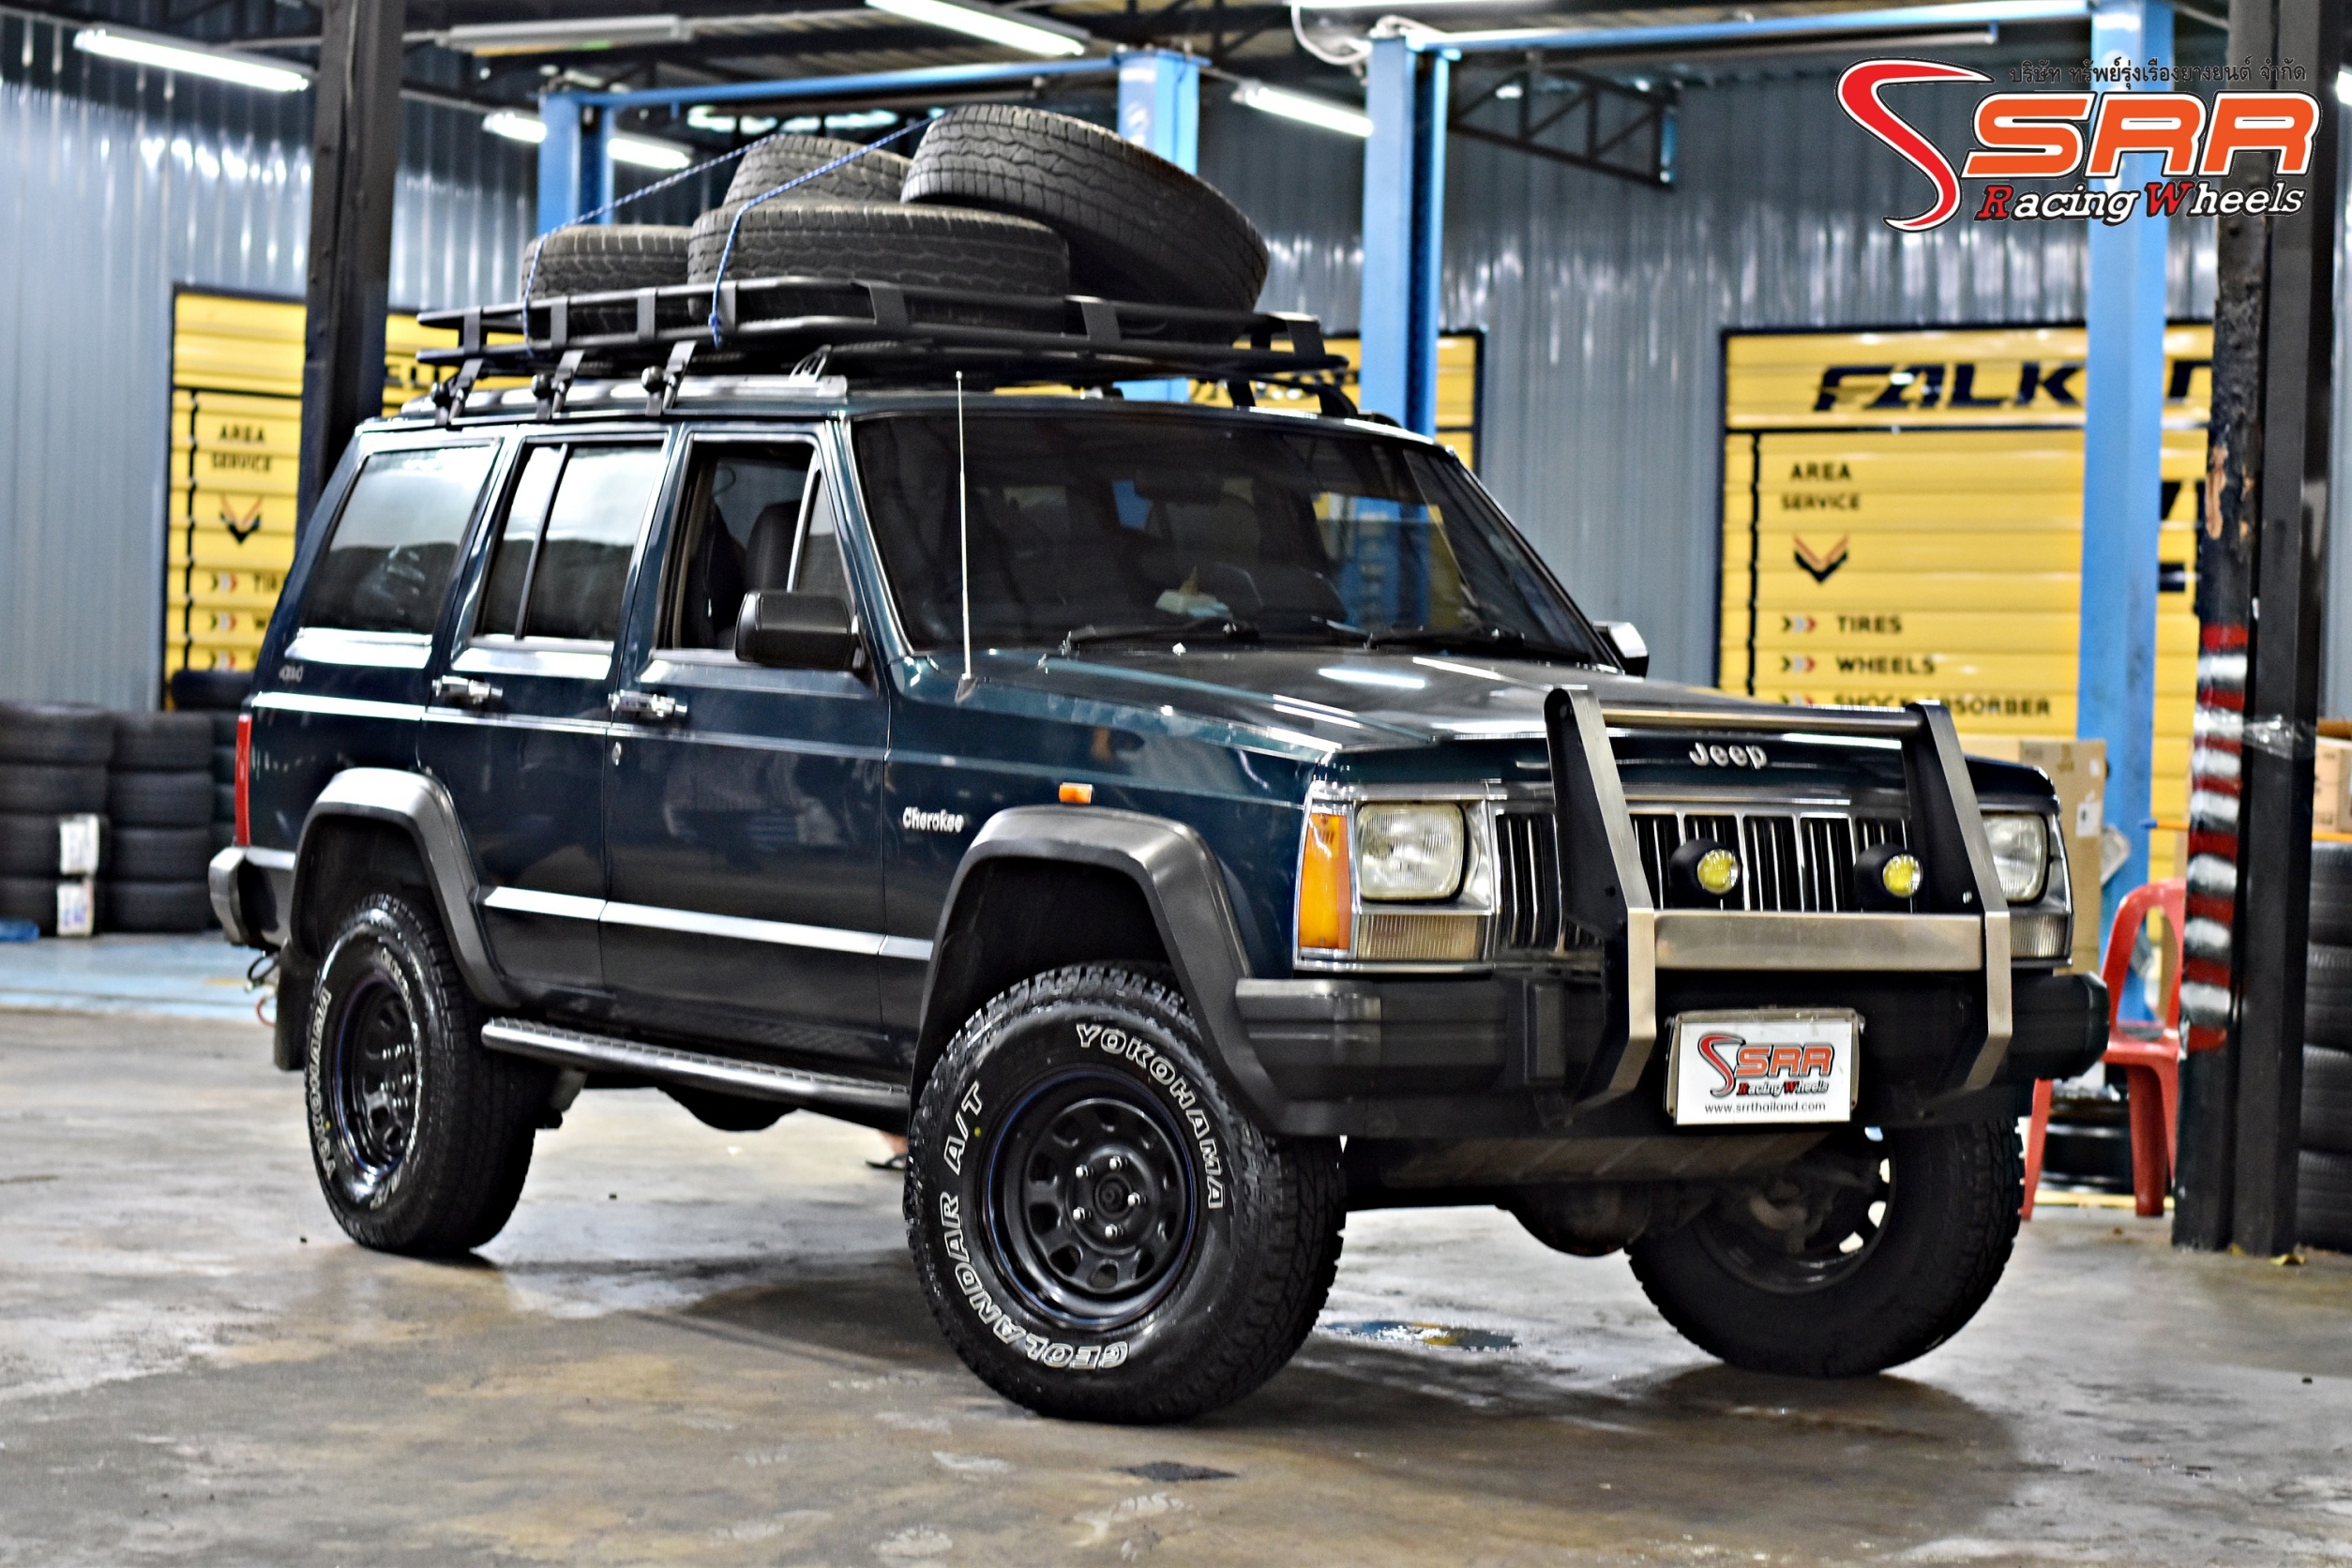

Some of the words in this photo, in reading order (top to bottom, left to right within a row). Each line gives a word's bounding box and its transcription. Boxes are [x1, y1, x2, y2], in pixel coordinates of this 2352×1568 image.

[218, 425, 265, 444] AREA
[211, 452, 273, 473] SERVICE
[1789, 461, 1852, 482] AREA
[1781, 491, 1861, 512] SERVICE
[1835, 613, 1903, 635] TIRES
[1834, 654, 1936, 677] WHEELS
[1930, 696, 2051, 717] BSORBER
[1688, 742, 1768, 770] Jeep
[902, 806, 965, 834] Cherokee
[1736, 1080, 1784, 1097] Racing
[1783, 1079, 1830, 1095] Wheels
[1075, 1022, 1225, 1210] YOKOHAMA
[1704, 1100, 1826, 1114] www.srrthailand.com
[942, 1080, 985, 1176] A/T
[939, 1190, 1129, 1370] GEOLANDAR
